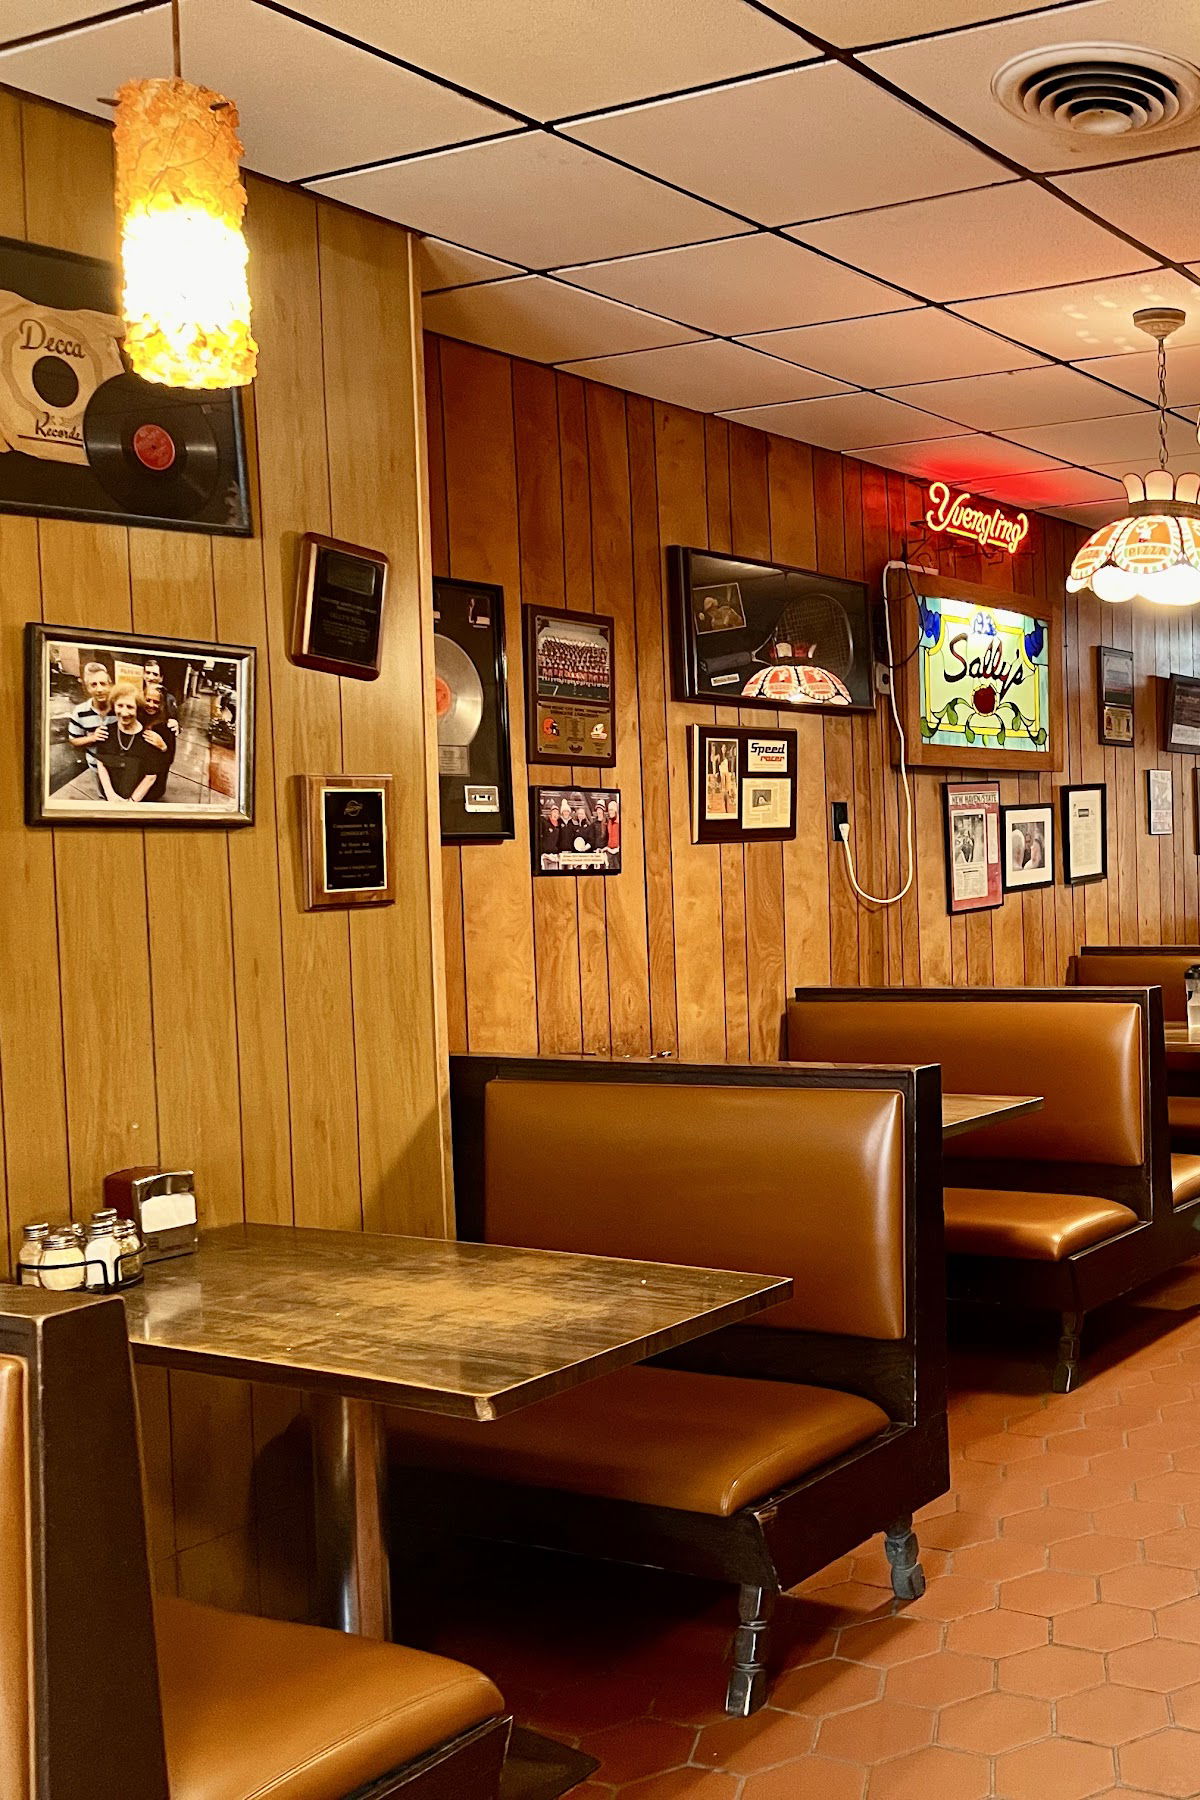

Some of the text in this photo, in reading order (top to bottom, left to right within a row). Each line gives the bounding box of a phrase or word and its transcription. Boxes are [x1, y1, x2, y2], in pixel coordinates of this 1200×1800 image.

[19, 318, 87, 359] Decca
[34, 411, 84, 442] Records
[925, 481, 1030, 554] Yuengling
[1128, 545, 1168, 557] PIZZA
[943, 632, 1026, 702] Sally's
[750, 742, 785, 756] Speed
